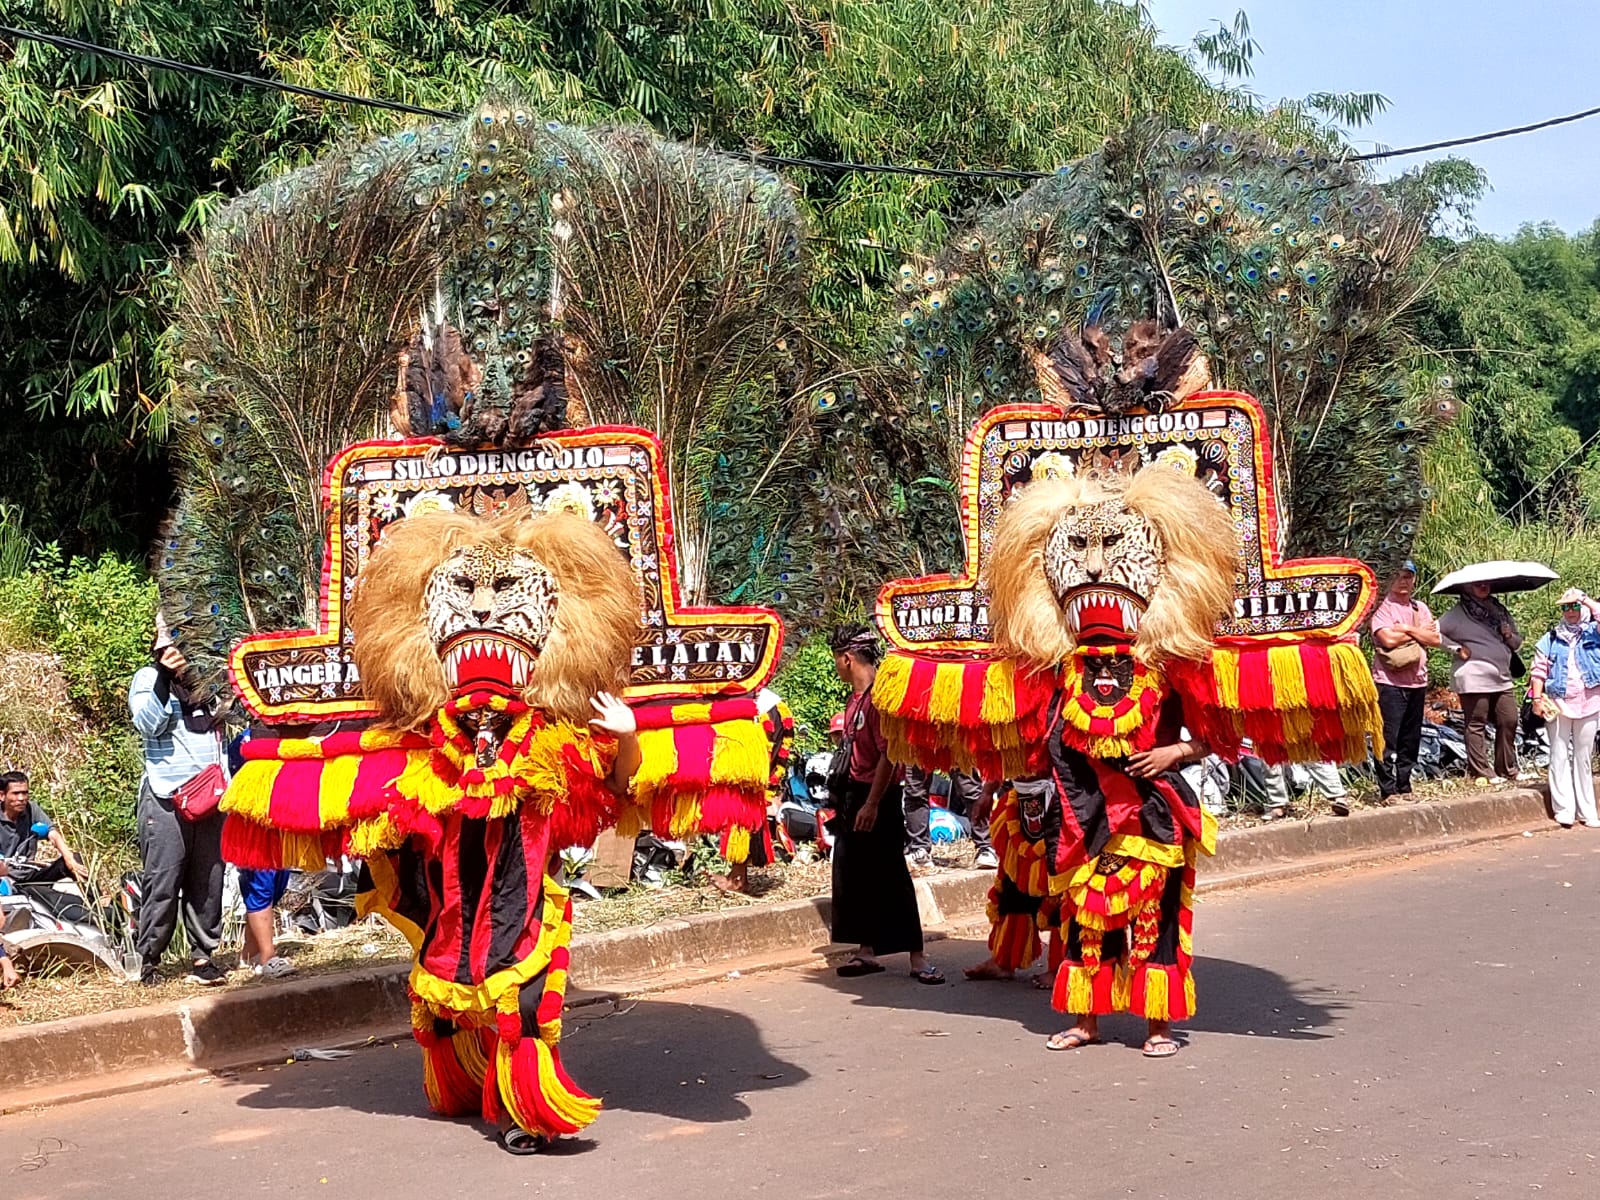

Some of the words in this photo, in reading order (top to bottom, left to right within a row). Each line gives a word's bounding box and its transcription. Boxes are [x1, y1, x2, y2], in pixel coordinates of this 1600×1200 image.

[1030, 420, 1081, 440] SURO
[1084, 412, 1200, 438] DJENGGOLO
[459, 447, 603, 475] DJENGGOLO
[896, 605, 989, 628] TANGERA
[1233, 591, 1350, 619] SELATAN
[630, 641, 755, 667] ELATAN
[254, 662, 360, 690] TANGERA
